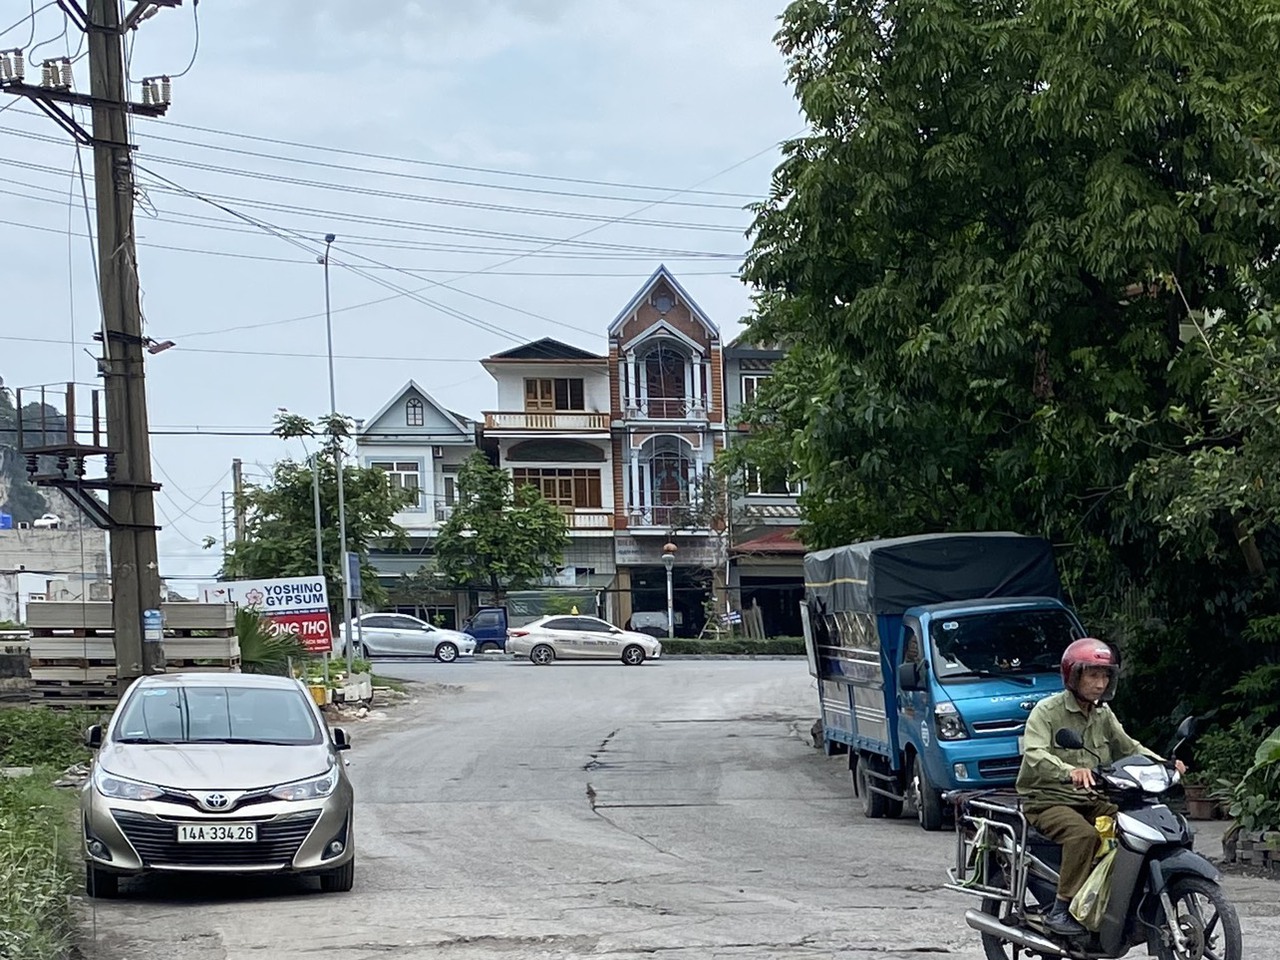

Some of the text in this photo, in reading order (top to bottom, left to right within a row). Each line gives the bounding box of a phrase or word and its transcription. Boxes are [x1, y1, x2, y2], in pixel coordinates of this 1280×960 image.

[264, 582, 323, 596] YOSHINO
[266, 593, 324, 606] GYPSUM
[182, 826, 254, 840] 14A-334.26
